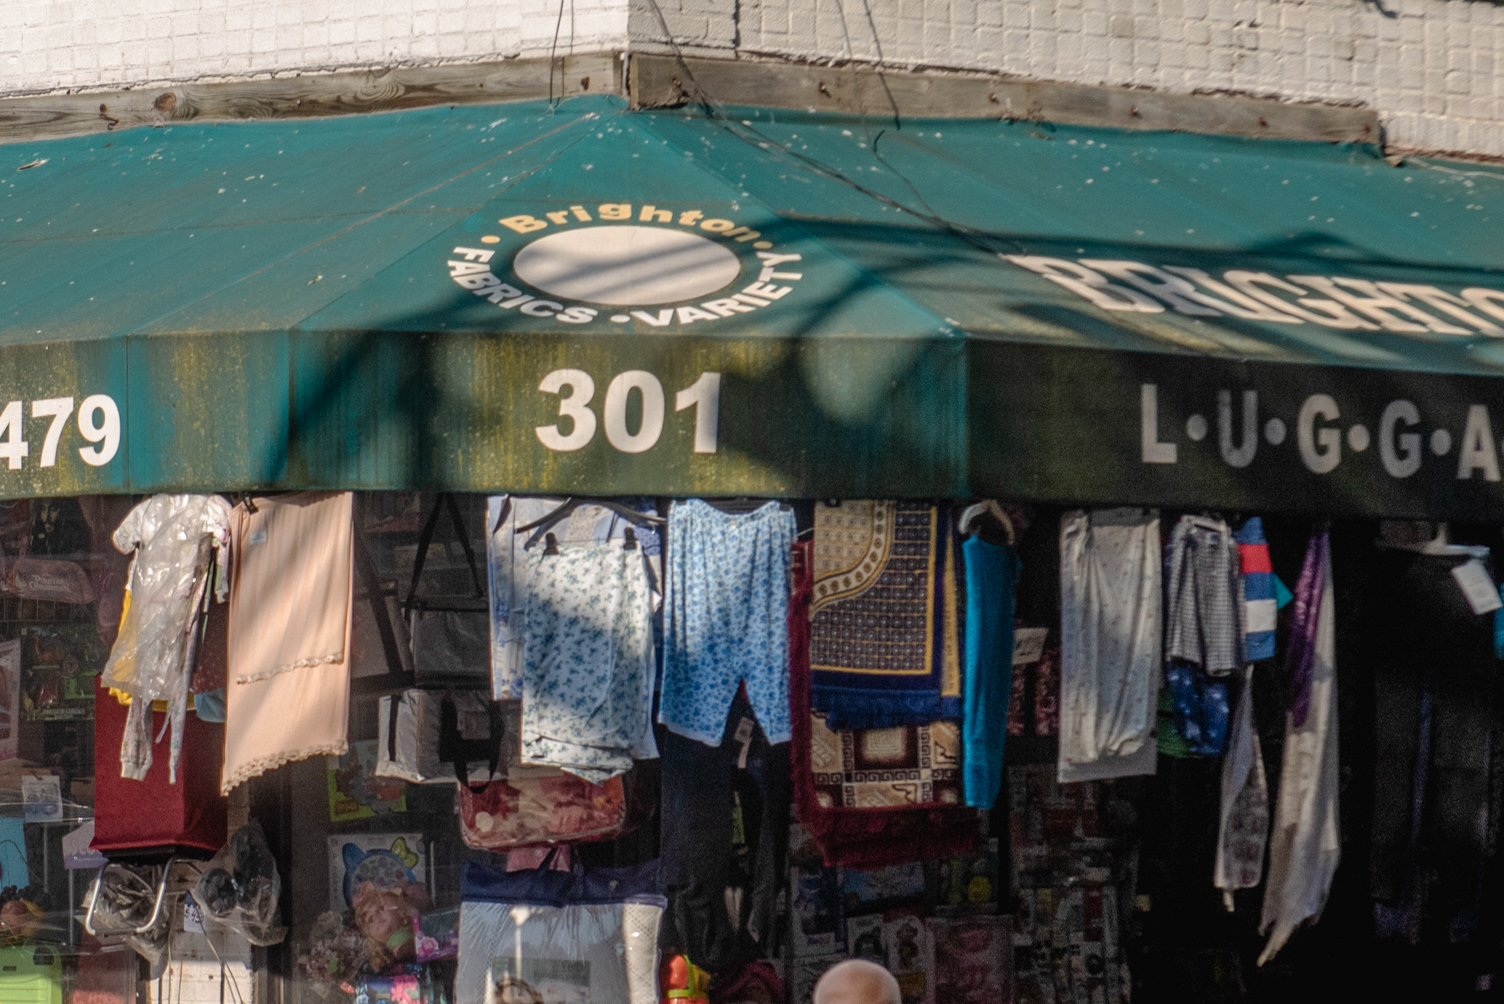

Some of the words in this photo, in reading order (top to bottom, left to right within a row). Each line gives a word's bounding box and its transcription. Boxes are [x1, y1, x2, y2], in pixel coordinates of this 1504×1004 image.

[499, 204, 762, 243] Brighton
[447, 246, 598, 325] FABRICS
[630, 250, 803, 327] VARIETY
[535, 368, 721, 454] 301
